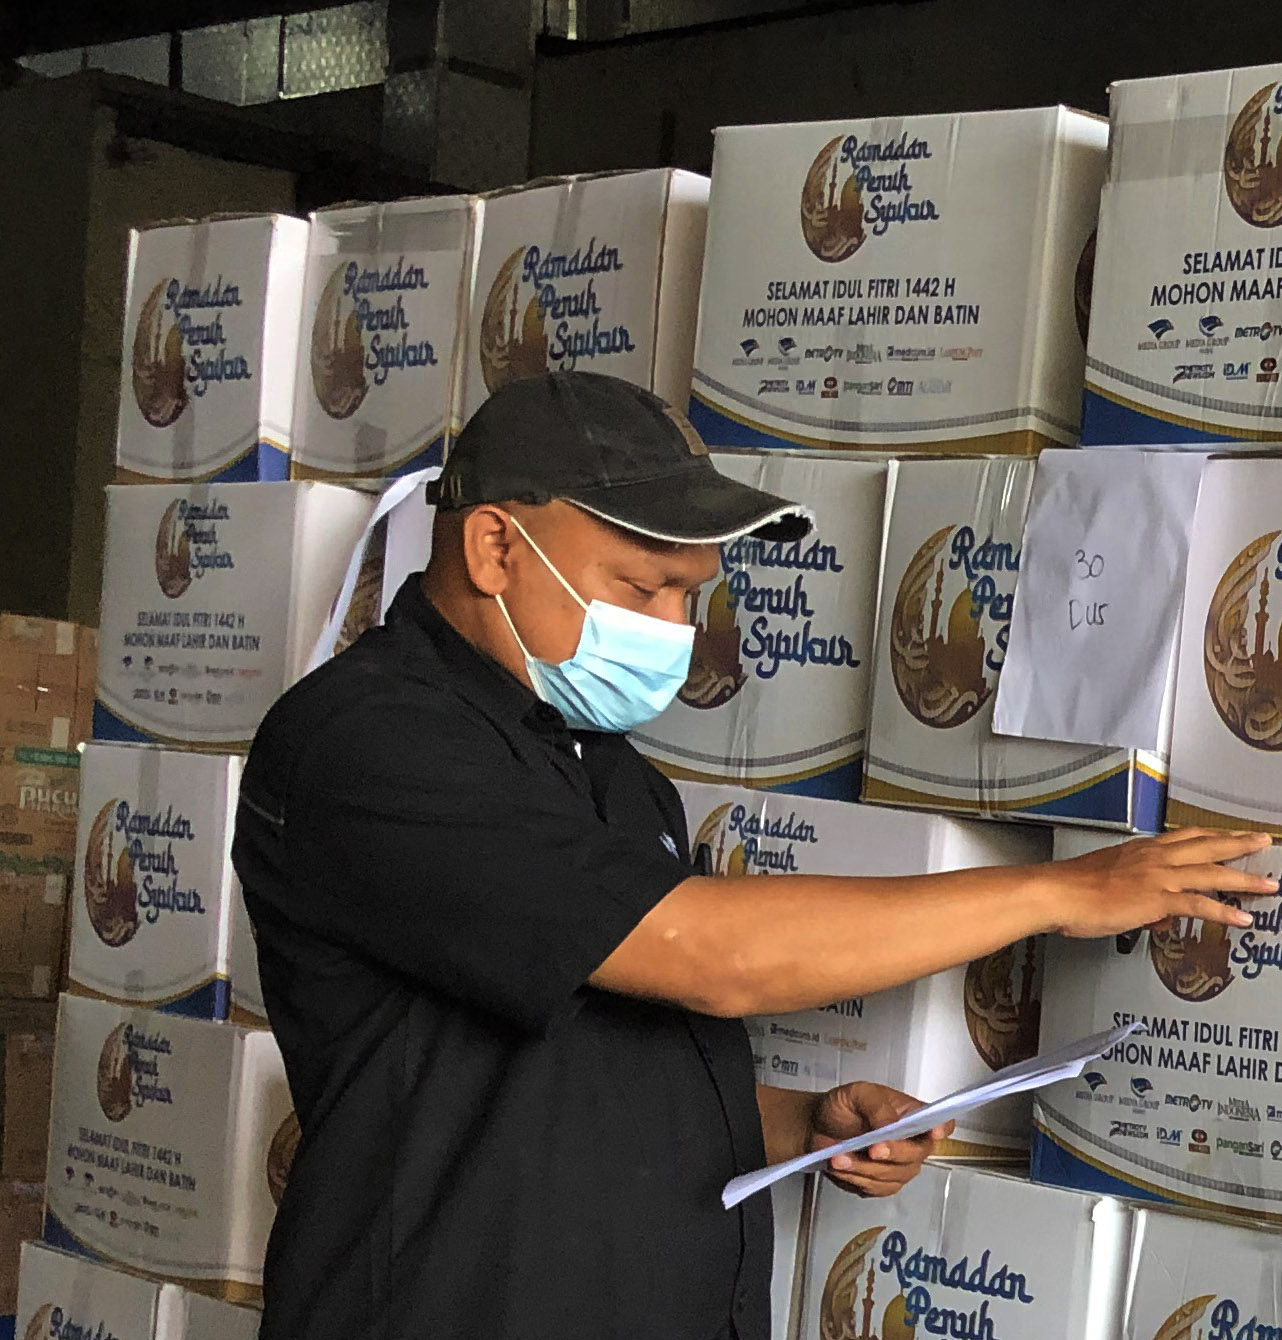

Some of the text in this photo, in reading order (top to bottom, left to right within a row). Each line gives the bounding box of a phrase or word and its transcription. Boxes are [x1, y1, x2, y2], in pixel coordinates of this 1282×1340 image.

[522, 237, 623, 289] Ramadan
[1183, 248, 1264, 275] SELAMAT
[538, 278, 602, 321] Penuh
[1150, 282, 1225, 307] MOHON
[549, 317, 635, 371] Syukur
[720, 537, 844, 573] amadan
[1075, 549, 1104, 579] 30
[726, 573, 814, 618] Penuh
[742, 617, 860, 679] Syukur
[1112, 1012, 1190, 1042] SELAMAT
[1194, 1022, 1233, 1047] IDUL
[1238, 1027, 1279, 1052] FITRI
[1101, 1042, 1152, 1067] OHON
[1158, 1047, 1211, 1075] MAAF
[1216, 1054, 1268, 1081] LAHIR
[879, 1230, 1034, 1304] Ramadan
